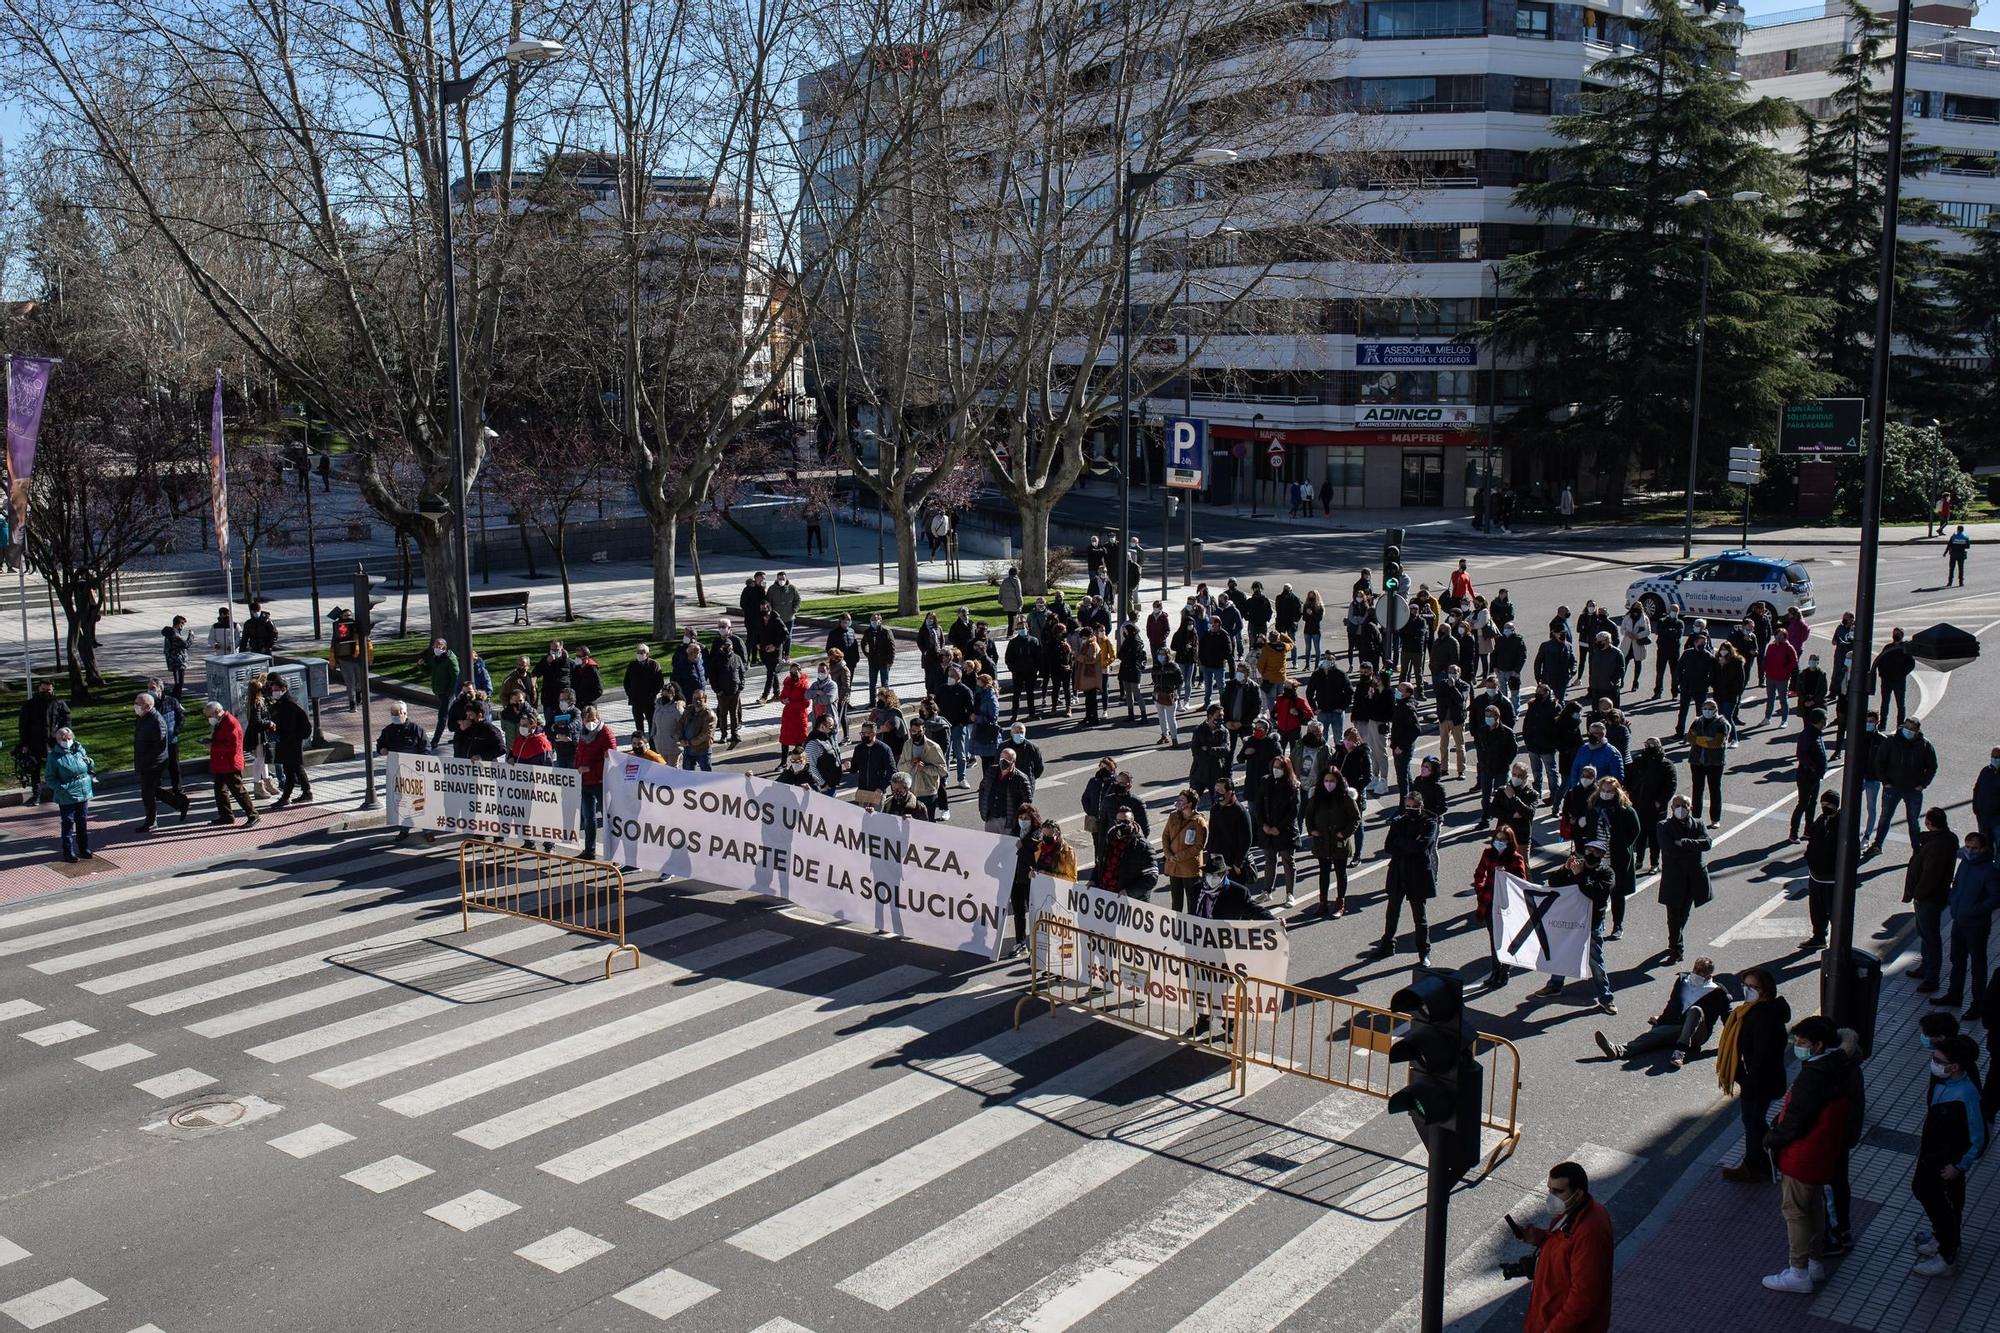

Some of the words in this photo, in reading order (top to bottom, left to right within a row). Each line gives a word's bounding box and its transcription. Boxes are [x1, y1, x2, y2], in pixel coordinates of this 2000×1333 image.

[1384, 344, 1430, 354] ASESORÍA
[1436, 346, 1471, 354] MIELGO
[1364, 409, 1442, 420] ADINCO
[1174, 421, 1196, 464] P
[1392, 434, 1443, 442] MAPFRE
[1181, 457, 1192, 465] 24h
[1685, 592, 1708, 600] Policía
[1710, 594, 1743, 602] Municipal
[415, 760, 425, 772] SI
[428, 761, 440, 774] LA
[443, 764, 507, 779] HOSTELERÍA
[510, 769, 576, 787] DESAPARECE
[394, 776, 424, 797] AHOSBE
[434, 780, 495, 797] BENAVENTE
[498, 787, 505, 798] Y
[507, 787, 558, 804] COMARCA
[469, 801, 482, 813] SE
[485, 803, 525, 818] APAGAN
[436, 816, 578, 842] #SOSHOSTELERIA
[637, 780, 674, 807] NO
[683, 788, 775, 825] SOMOS
[783, 808, 829, 842] UNA
[833, 826, 970, 879] AMENAZA,
[708, 835, 787, 873] PARTE
[793, 854, 818, 884] DE
[827, 864, 854, 894] LA
[1067, 889, 1090, 915] NO
[1094, 897, 1154, 933] SOMOS
[1159, 915, 1278, 951] CULPABLES
